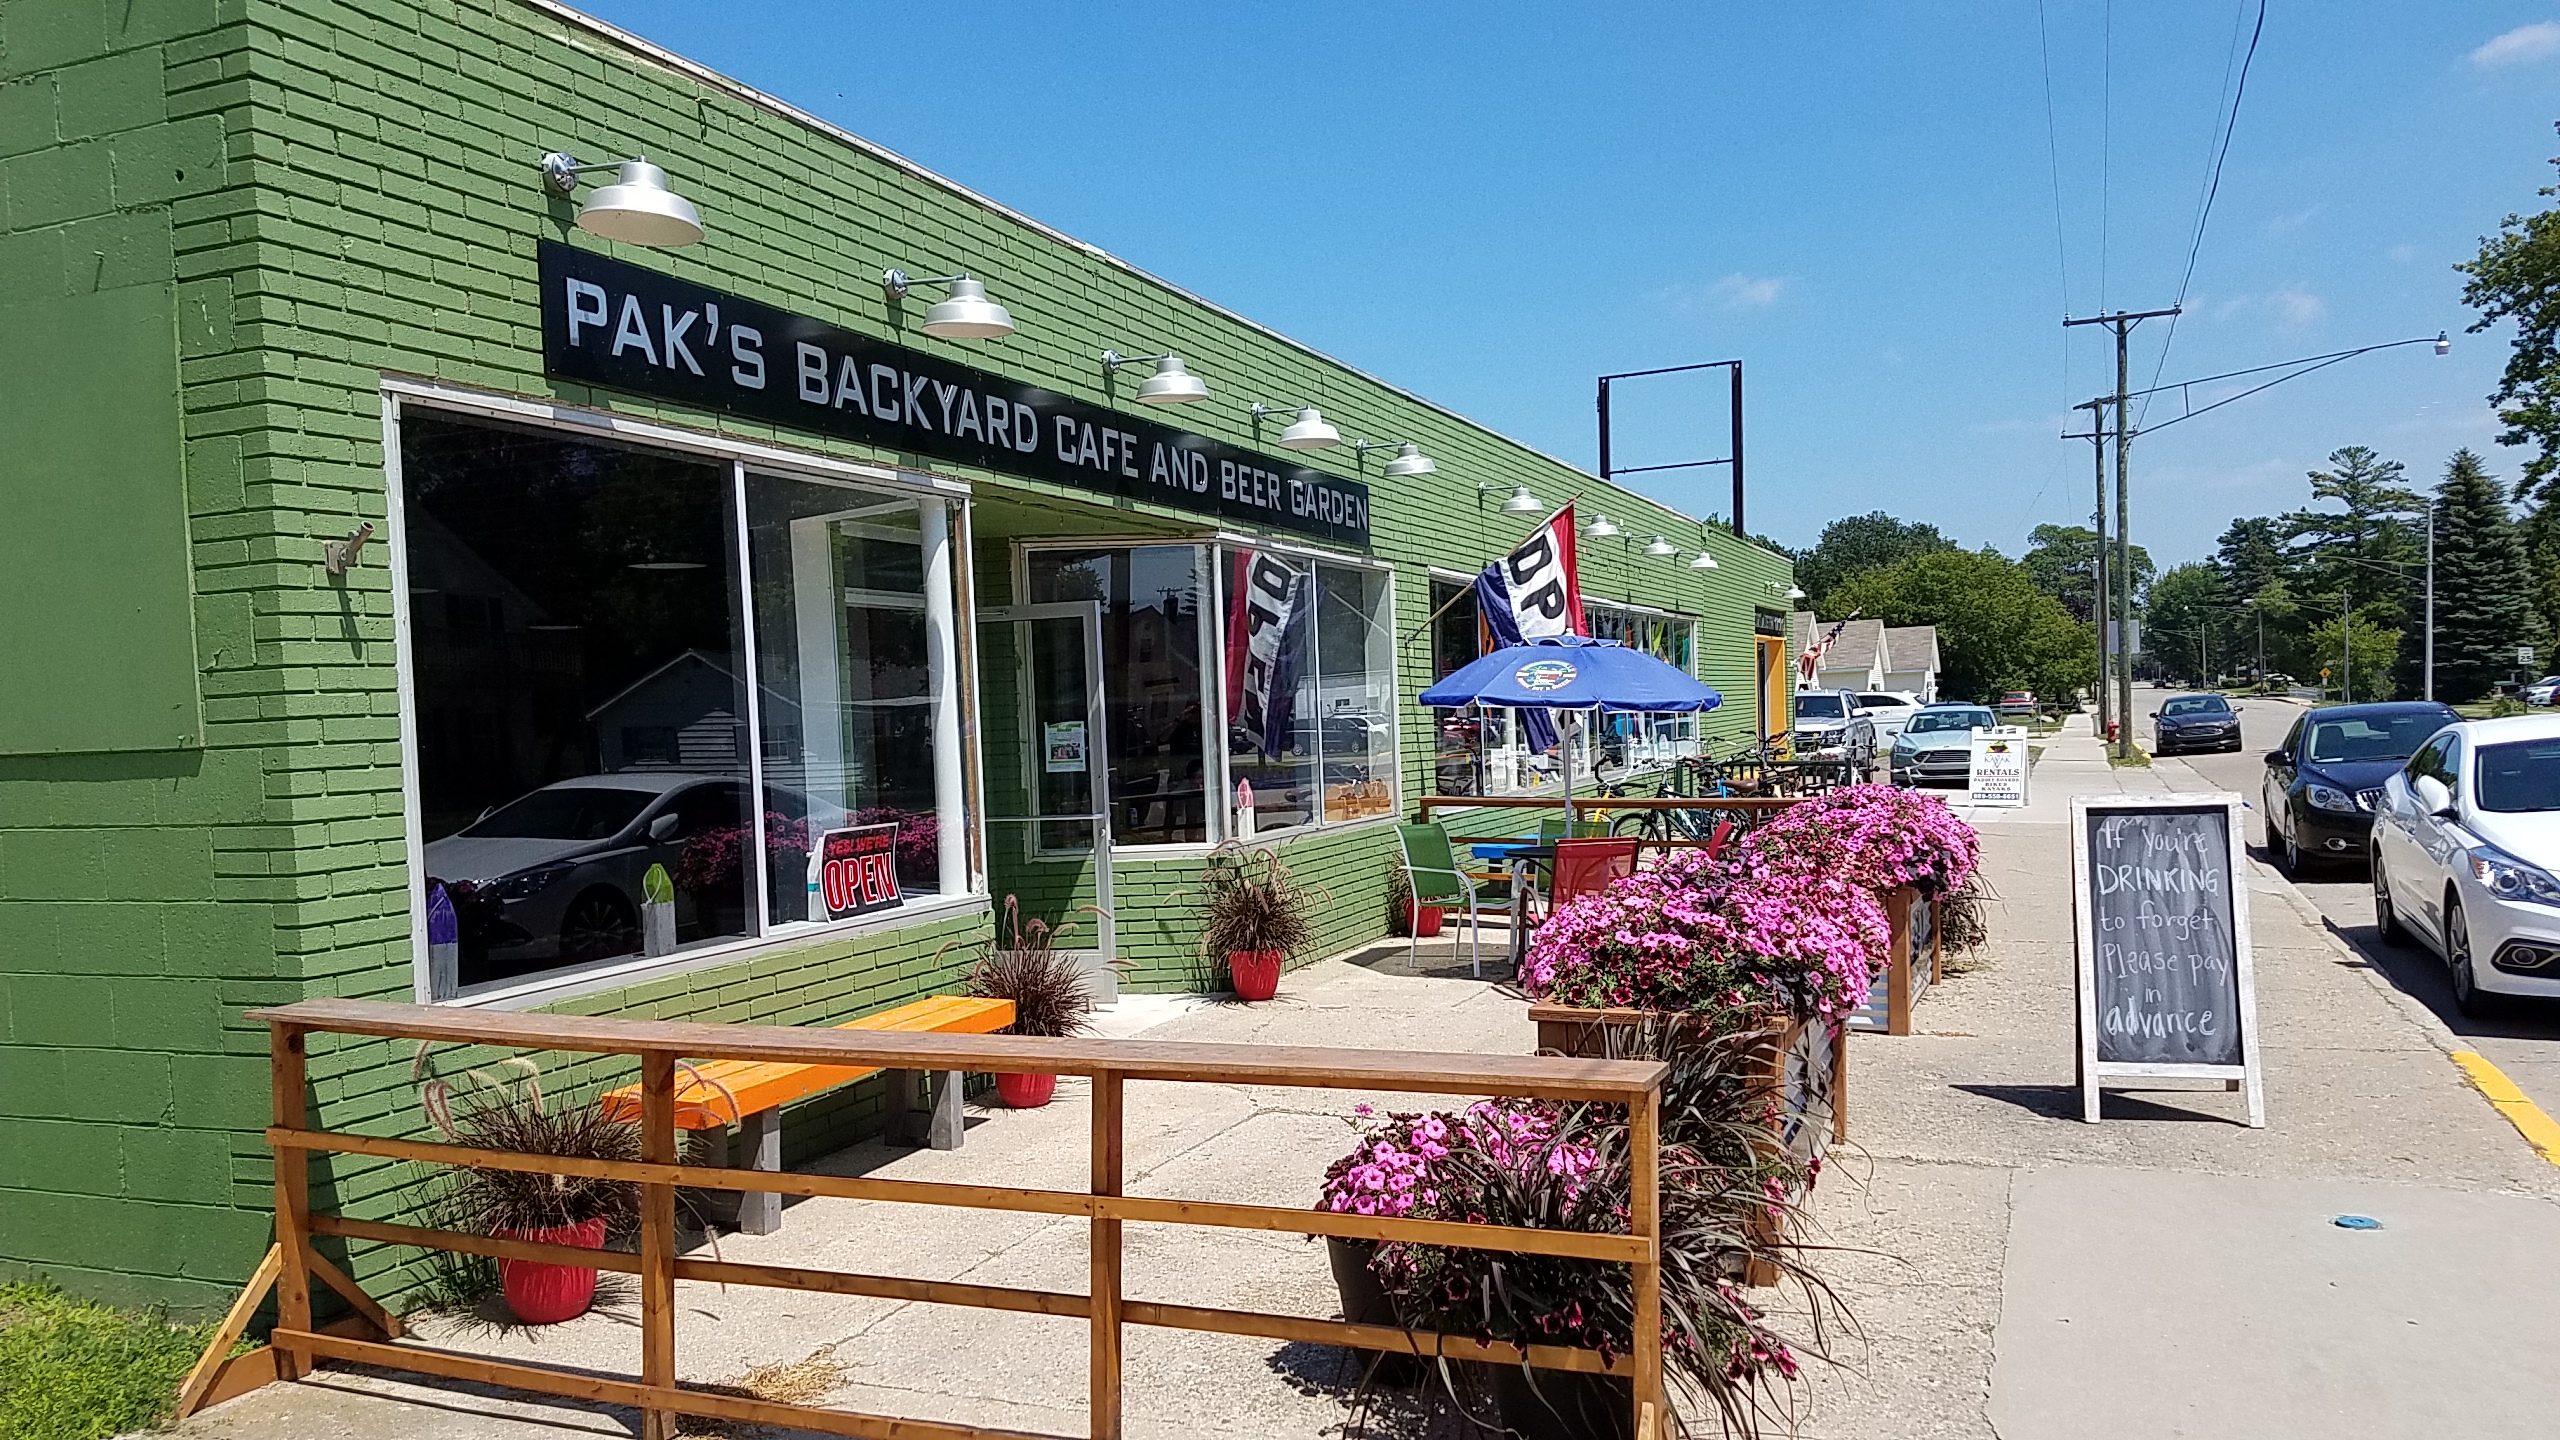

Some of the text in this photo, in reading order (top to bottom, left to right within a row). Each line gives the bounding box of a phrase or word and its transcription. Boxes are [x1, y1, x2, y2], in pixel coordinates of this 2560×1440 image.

[566, 277, 1368, 532] PAK'S BACKYARD CAFE AND BEER GARDEN
[1507, 533, 1565, 620] OP
[2520, 655, 2532, 663] 25
[2103, 819, 2125, 850] If
[824, 852, 899, 912] OPEN
[2097, 863, 2220, 897] DRINKING
[2100, 900, 2217, 941] to forget
[2102, 943, 2178, 979] Please
[2145, 987, 2162, 1003] in
[2105, 995, 2217, 1040] advance
